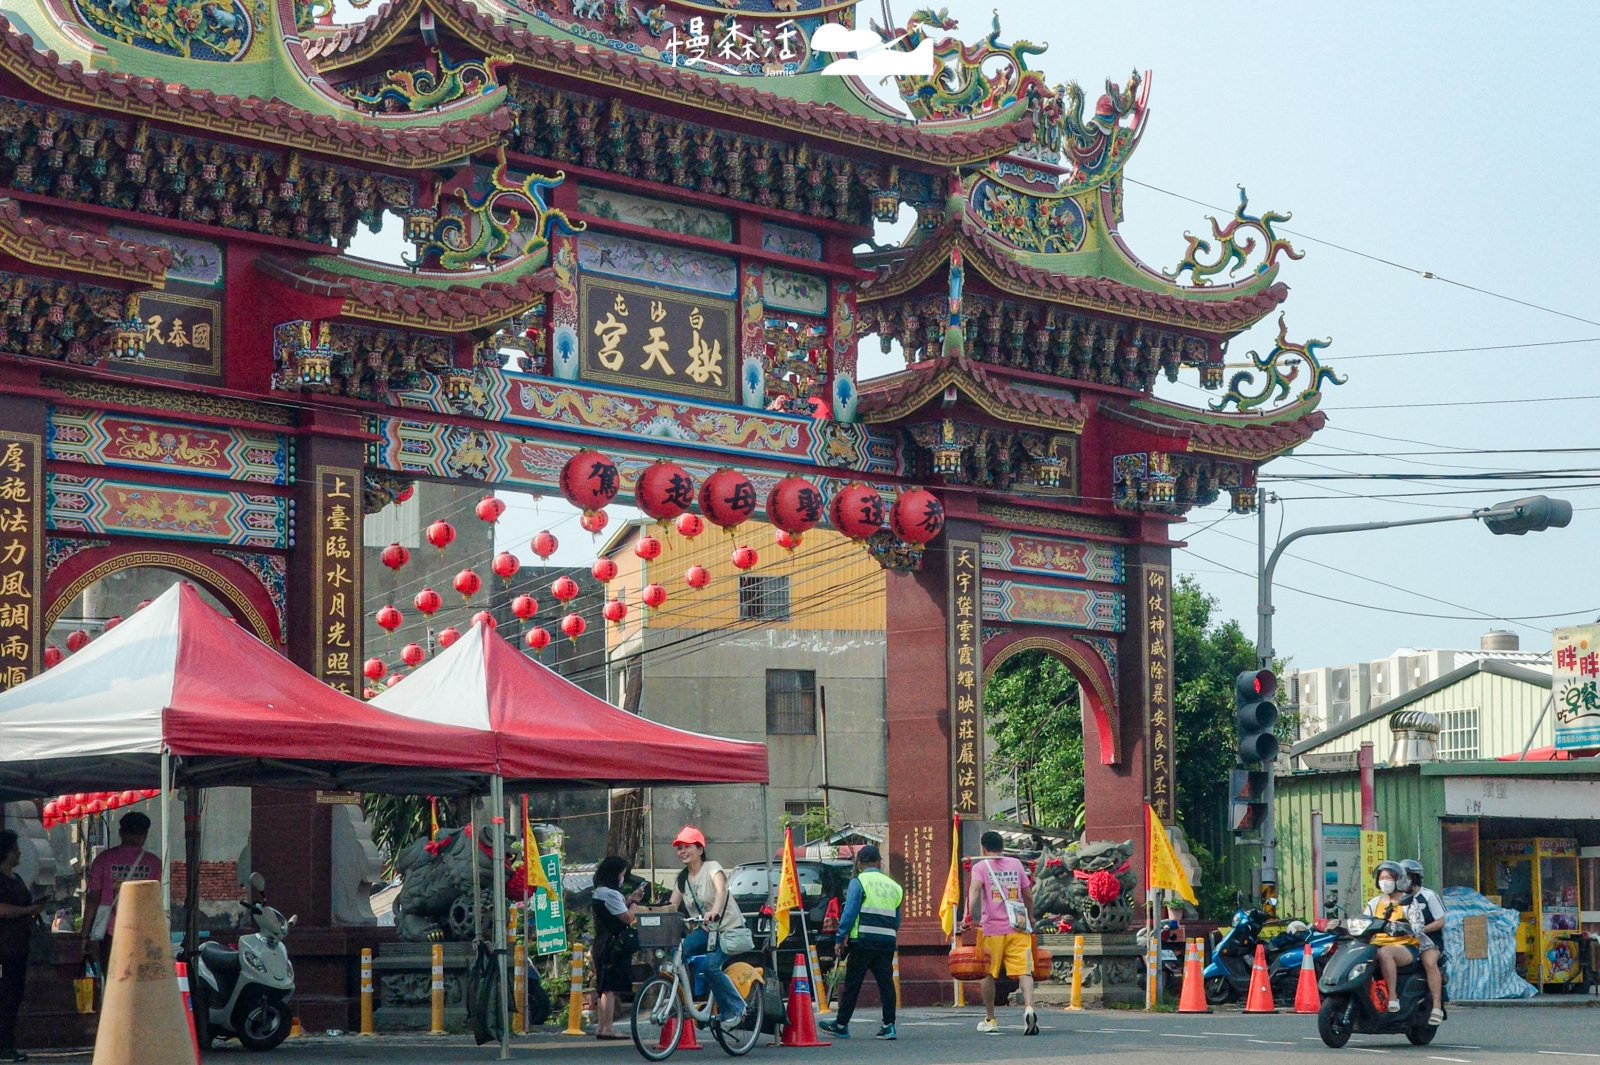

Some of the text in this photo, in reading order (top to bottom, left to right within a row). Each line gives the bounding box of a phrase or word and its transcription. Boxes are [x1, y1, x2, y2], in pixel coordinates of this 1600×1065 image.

[614, 293, 704, 330] 白沙屯
[146, 314, 211, 351] 國泰民
[593, 312, 723, 387] 拱天宮
[1557, 645, 1599, 678] 胖胖
